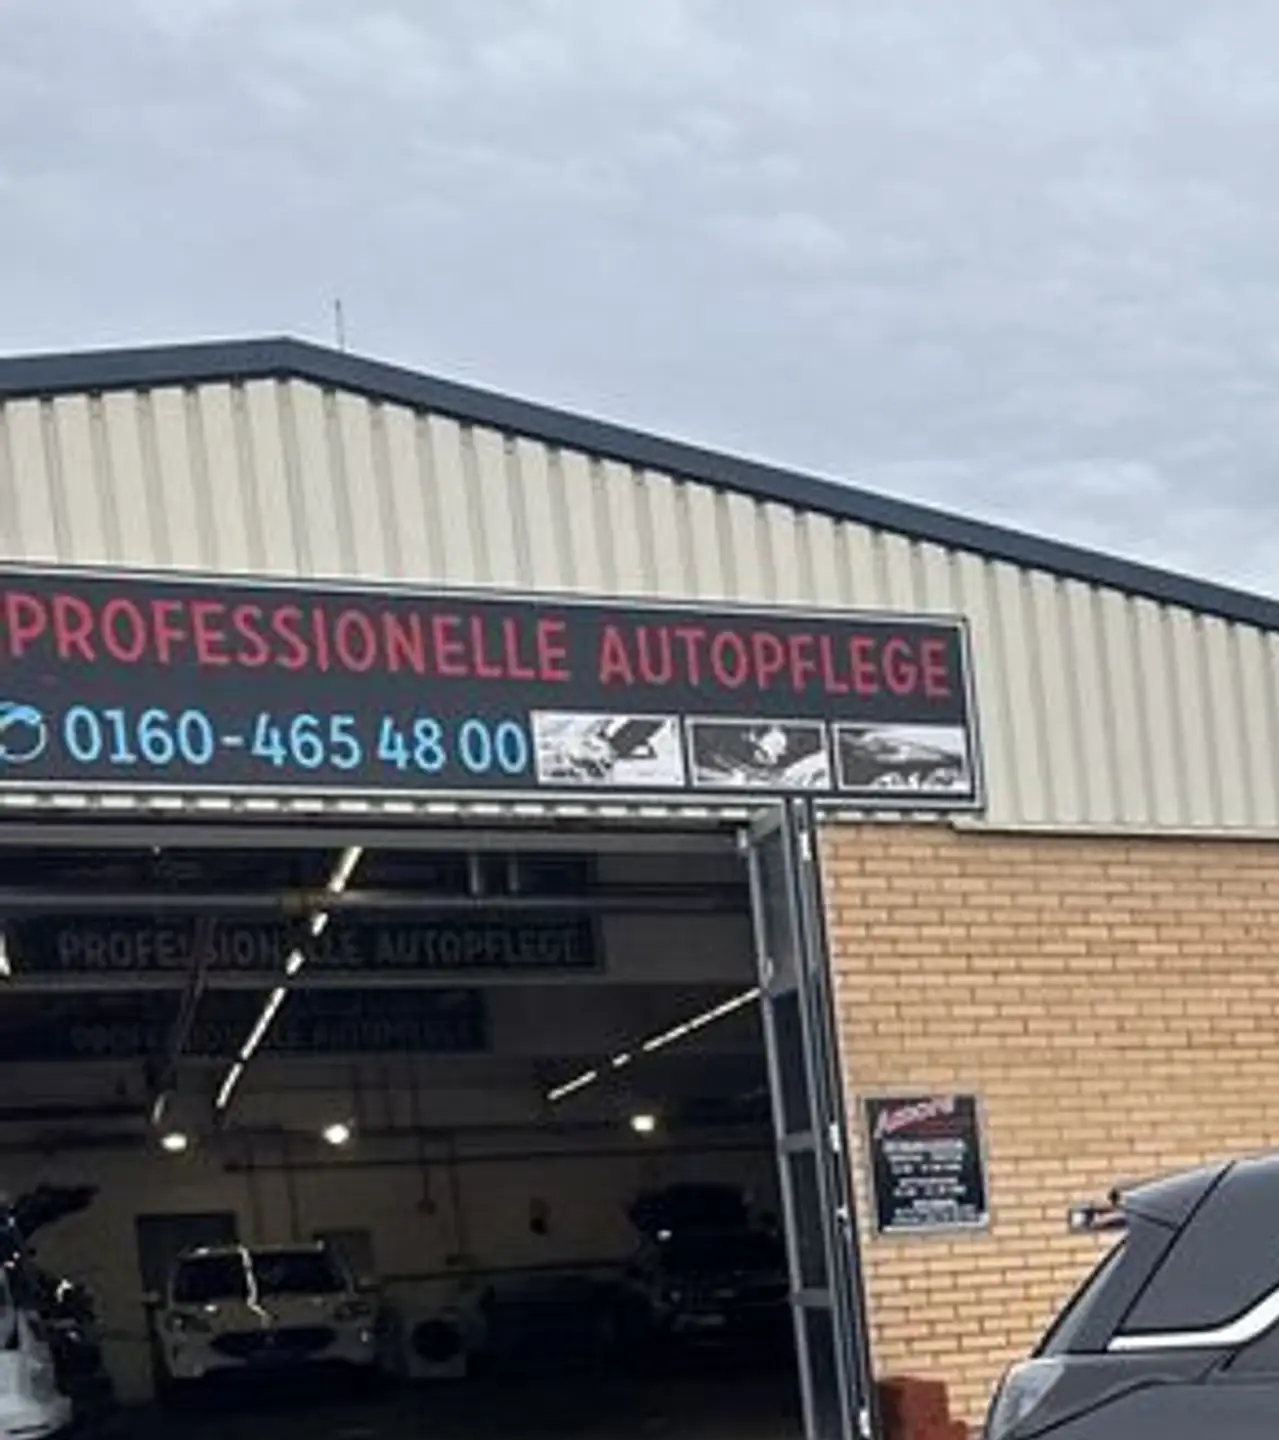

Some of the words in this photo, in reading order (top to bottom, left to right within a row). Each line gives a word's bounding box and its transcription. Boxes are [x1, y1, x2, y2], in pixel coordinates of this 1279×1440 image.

[6, 593, 572, 682] PROFESSIONELLE
[599, 624, 951, 697] AUTOPFLEGE
[459, 718, 529, 774] 00
